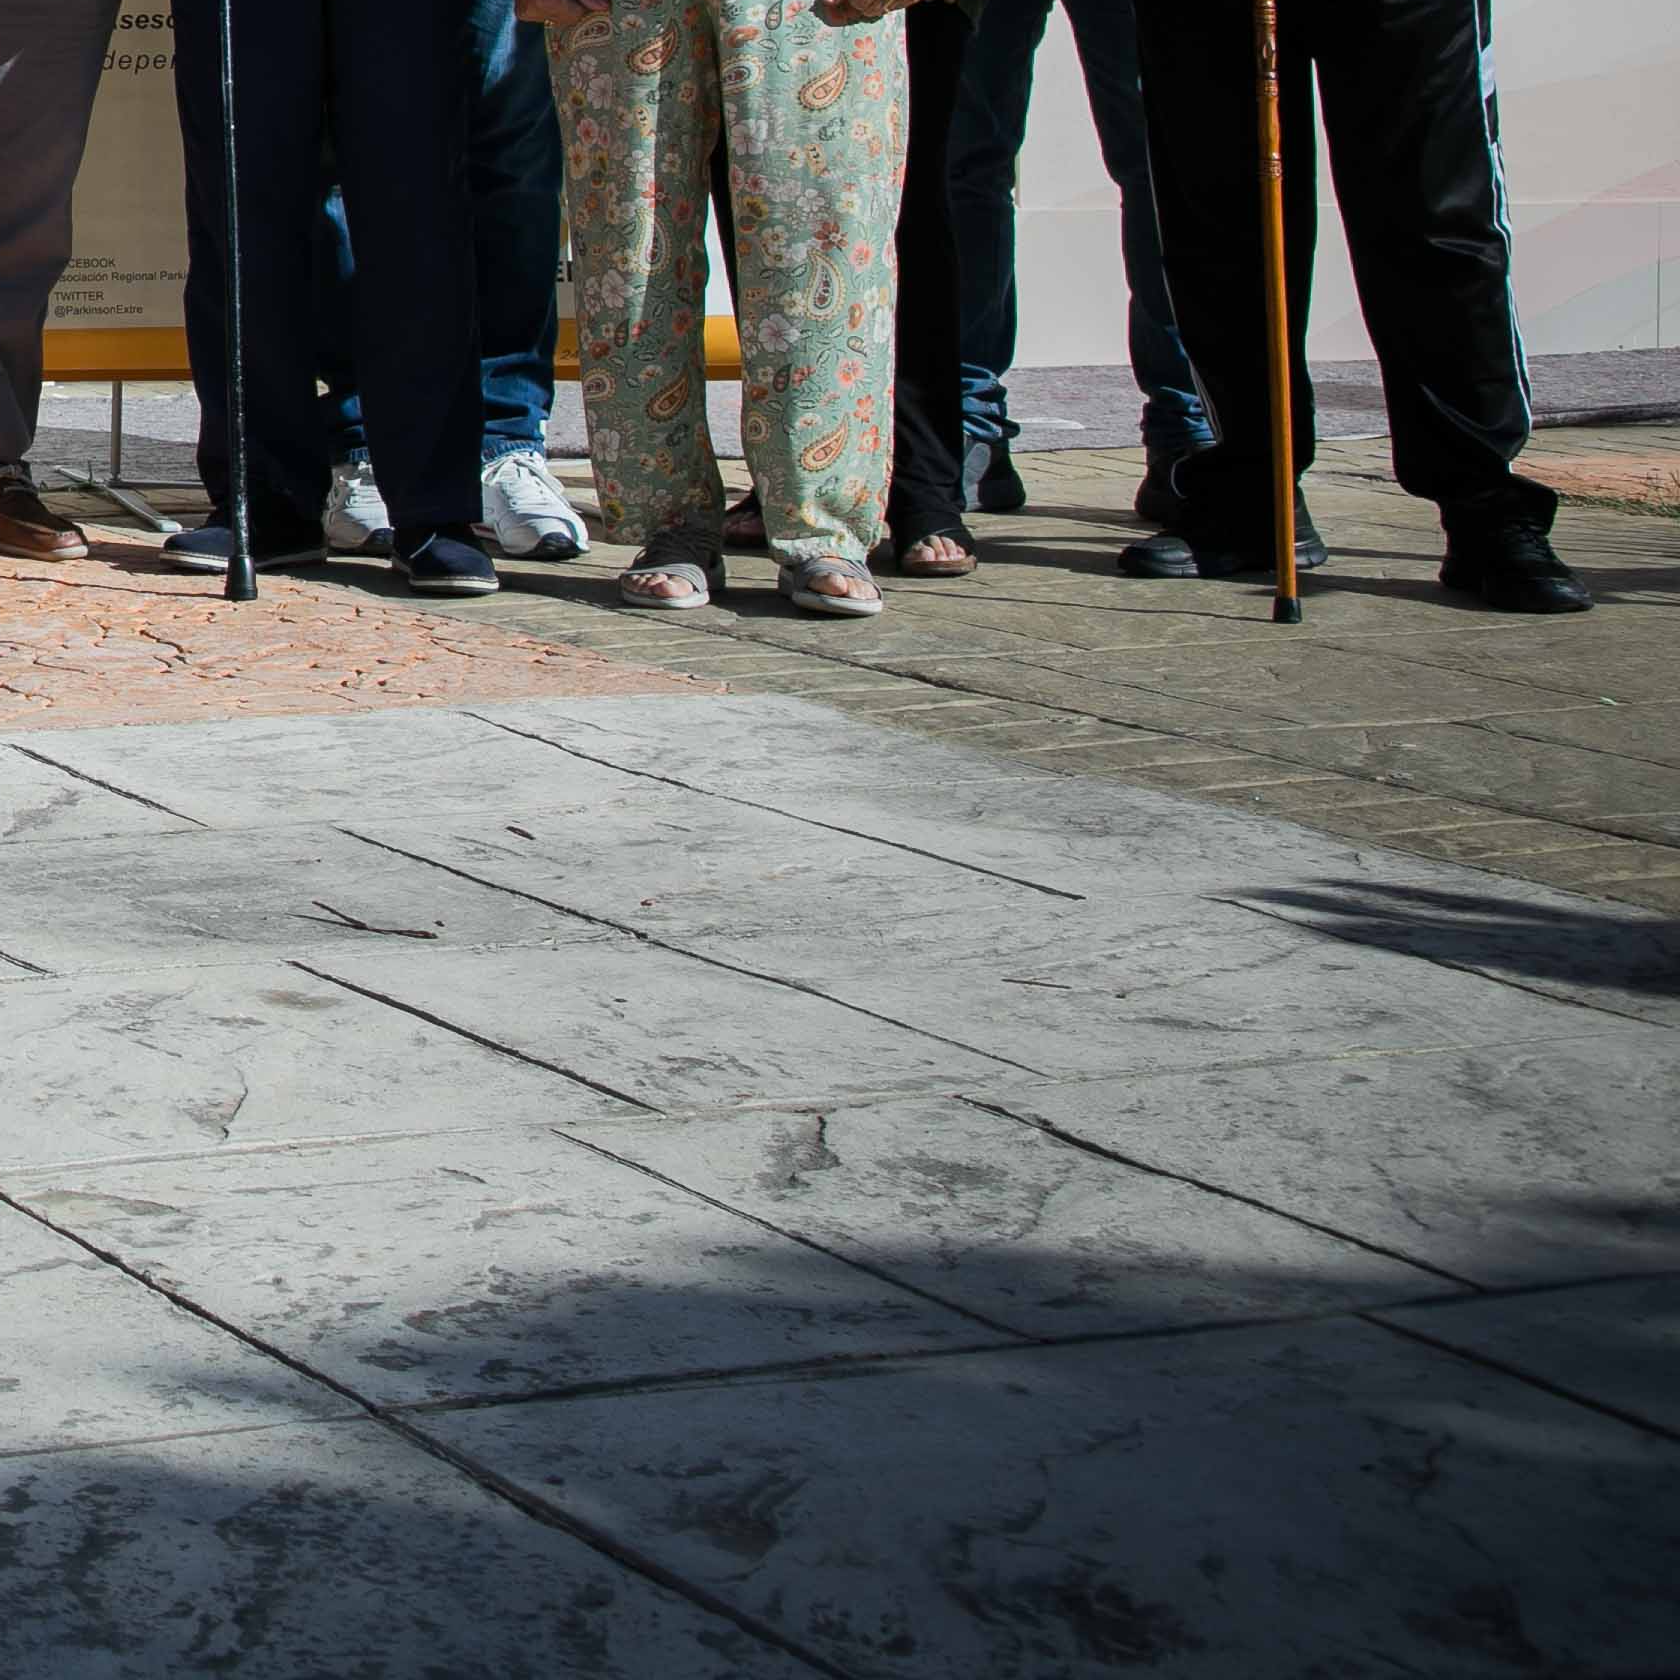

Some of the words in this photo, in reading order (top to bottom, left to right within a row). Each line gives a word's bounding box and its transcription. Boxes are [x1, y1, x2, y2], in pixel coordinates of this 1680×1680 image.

[111, 270, 158, 284] Regional
[54, 290, 105, 302] TWITTER
[54, 303, 144, 318] @ParkinsonExtre
